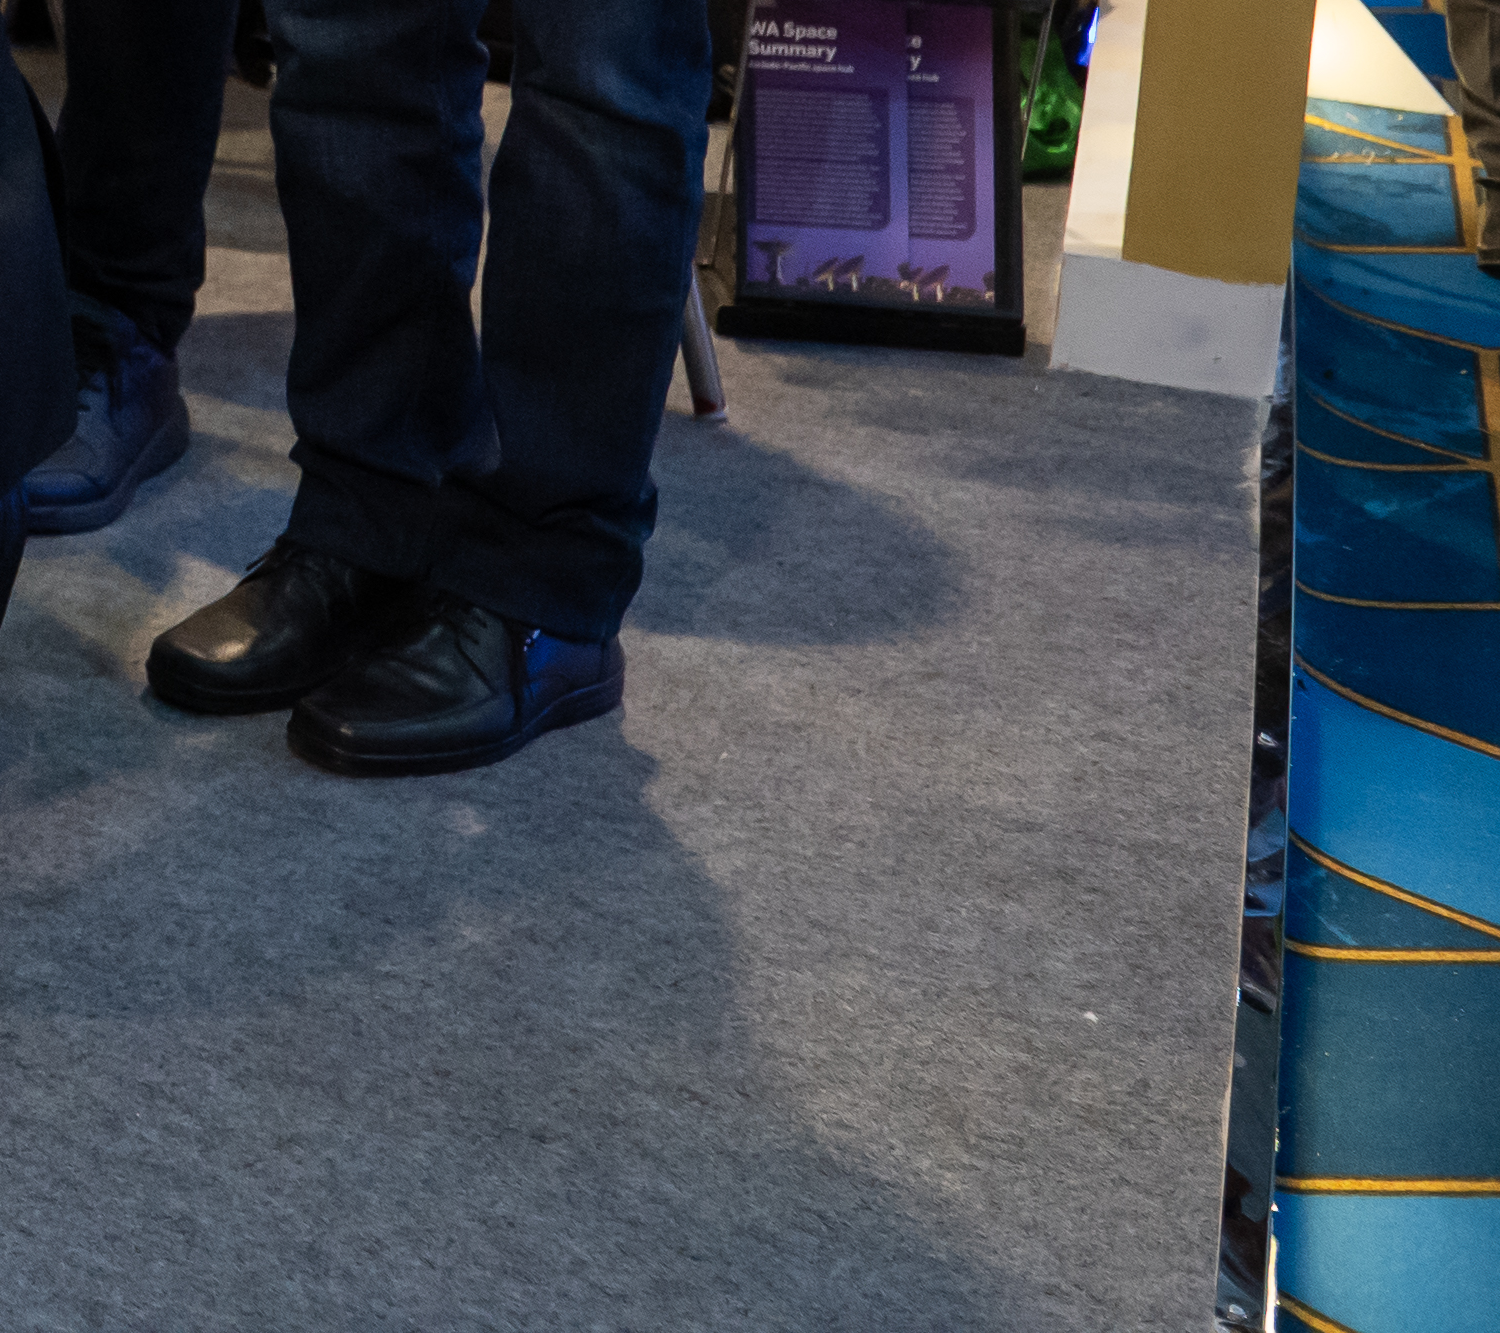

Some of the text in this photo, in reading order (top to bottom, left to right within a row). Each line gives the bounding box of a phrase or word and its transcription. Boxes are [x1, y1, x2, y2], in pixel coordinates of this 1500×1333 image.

[751, 20, 837, 41] WA Space
[749, 38, 837, 62] Summary
